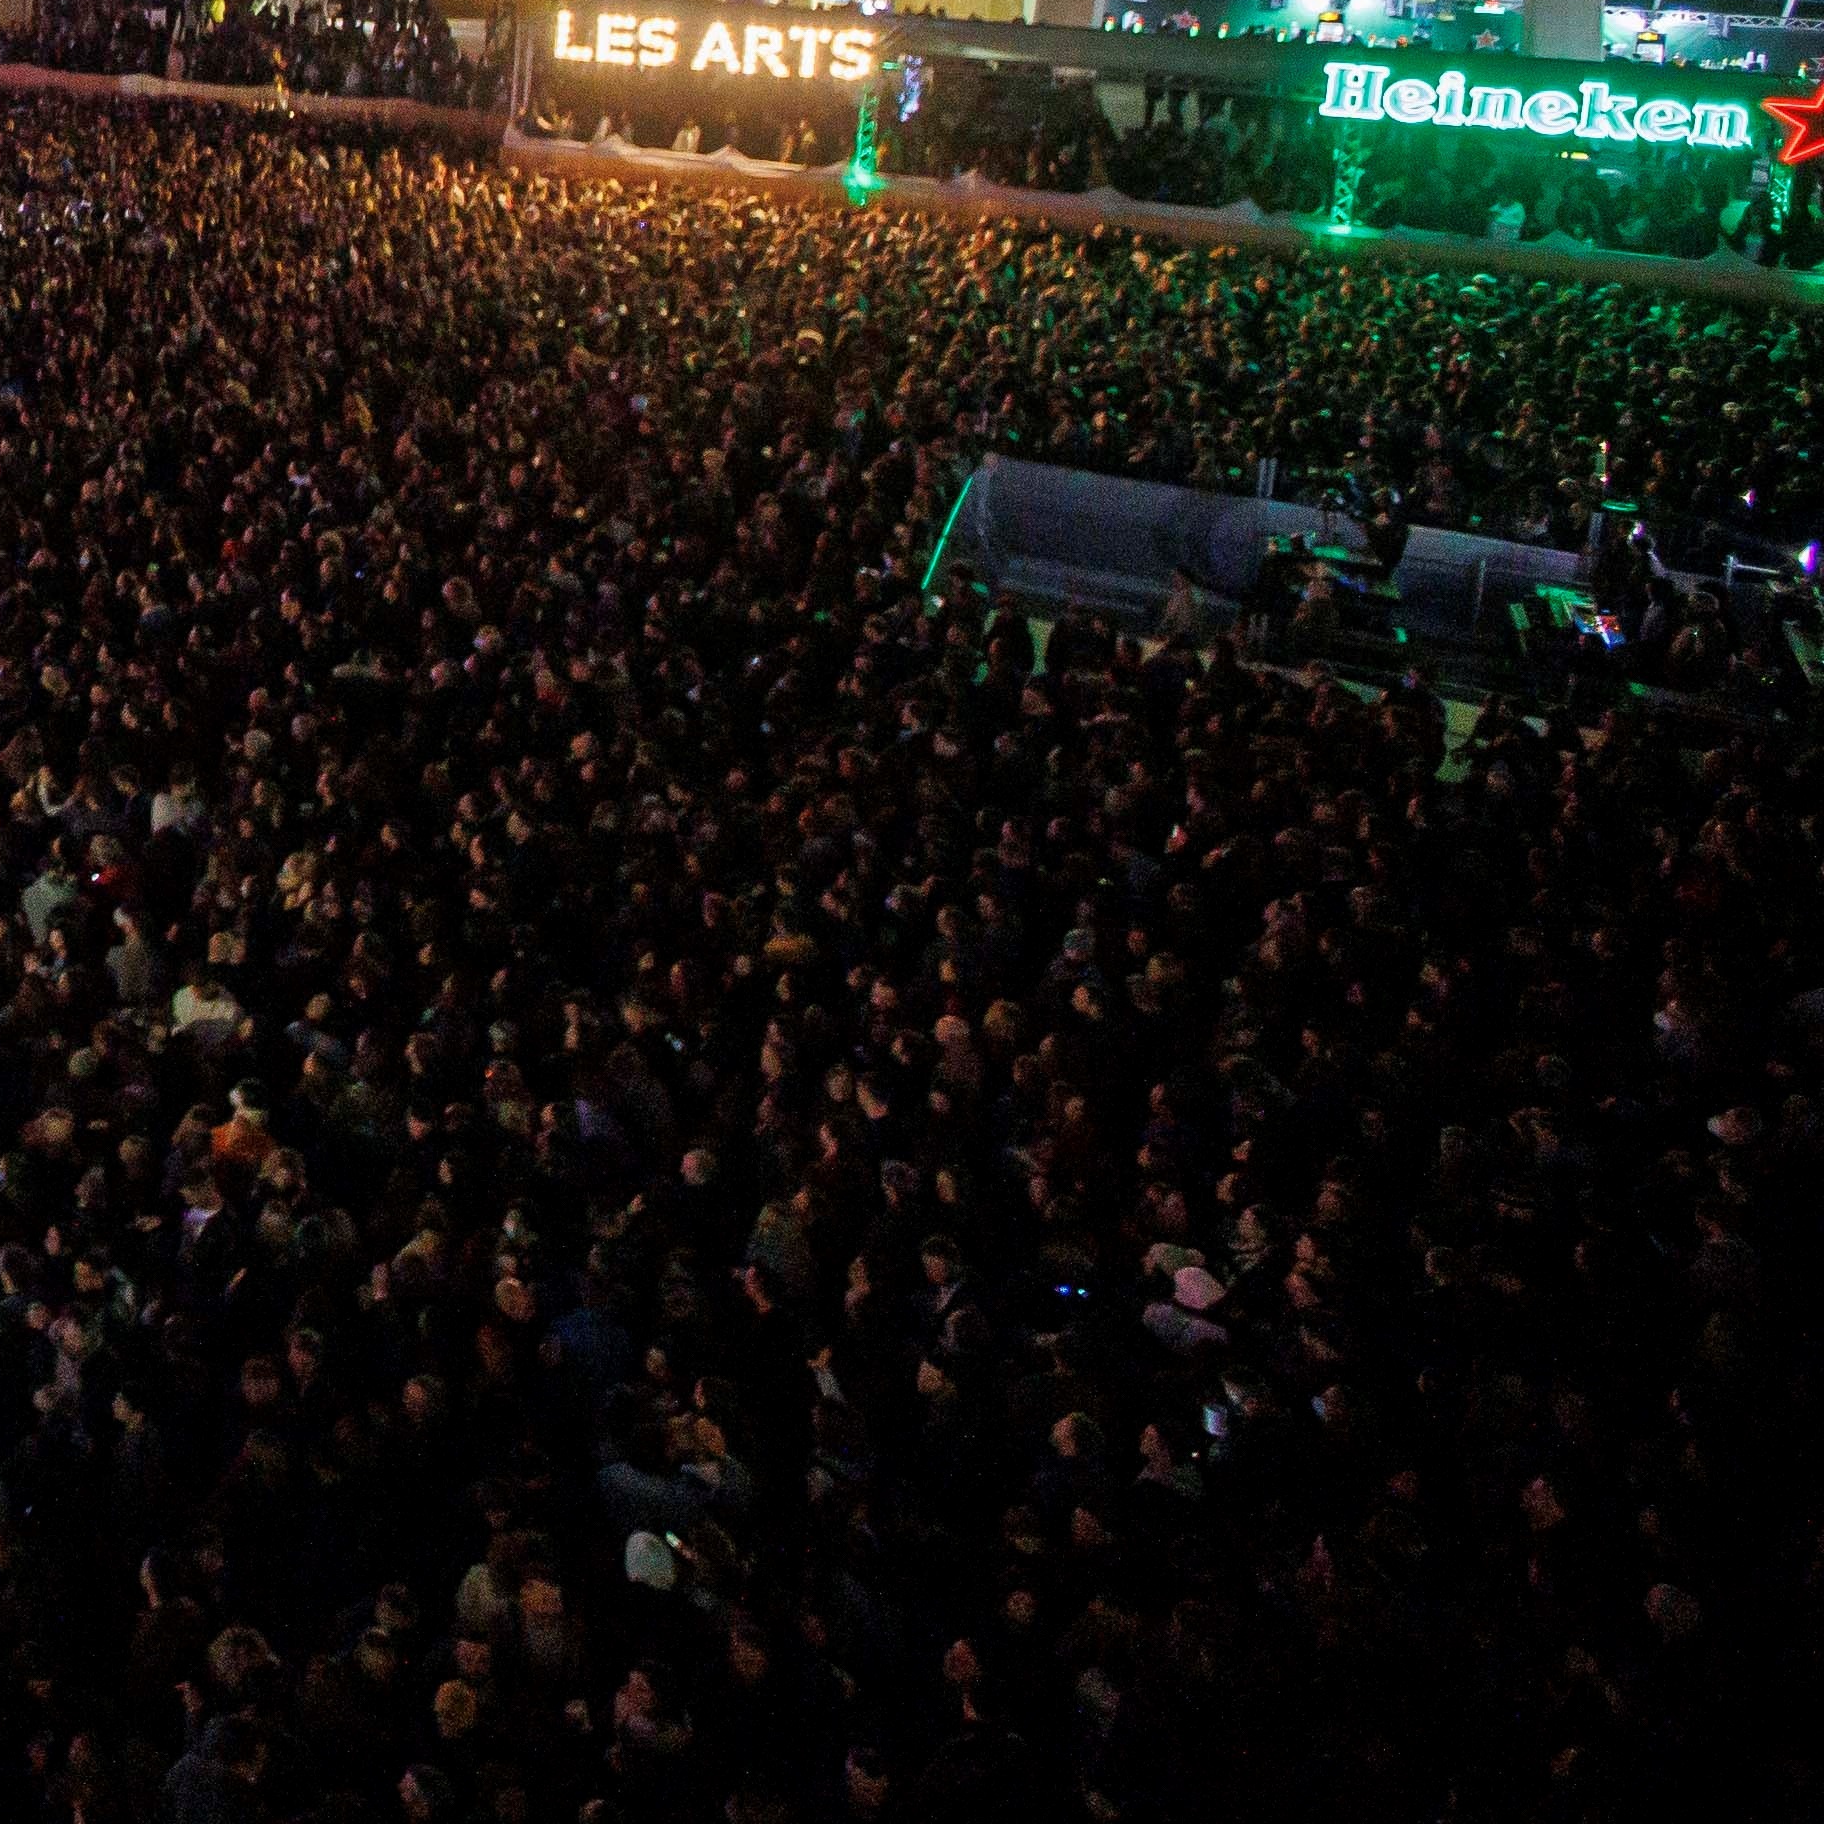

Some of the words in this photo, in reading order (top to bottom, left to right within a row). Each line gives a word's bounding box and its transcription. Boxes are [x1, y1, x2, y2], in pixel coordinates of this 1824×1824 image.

[553, 8, 680, 69] LES
[689, 20, 881, 82] ARTS
[1318, 61, 1753, 148] Heineken
